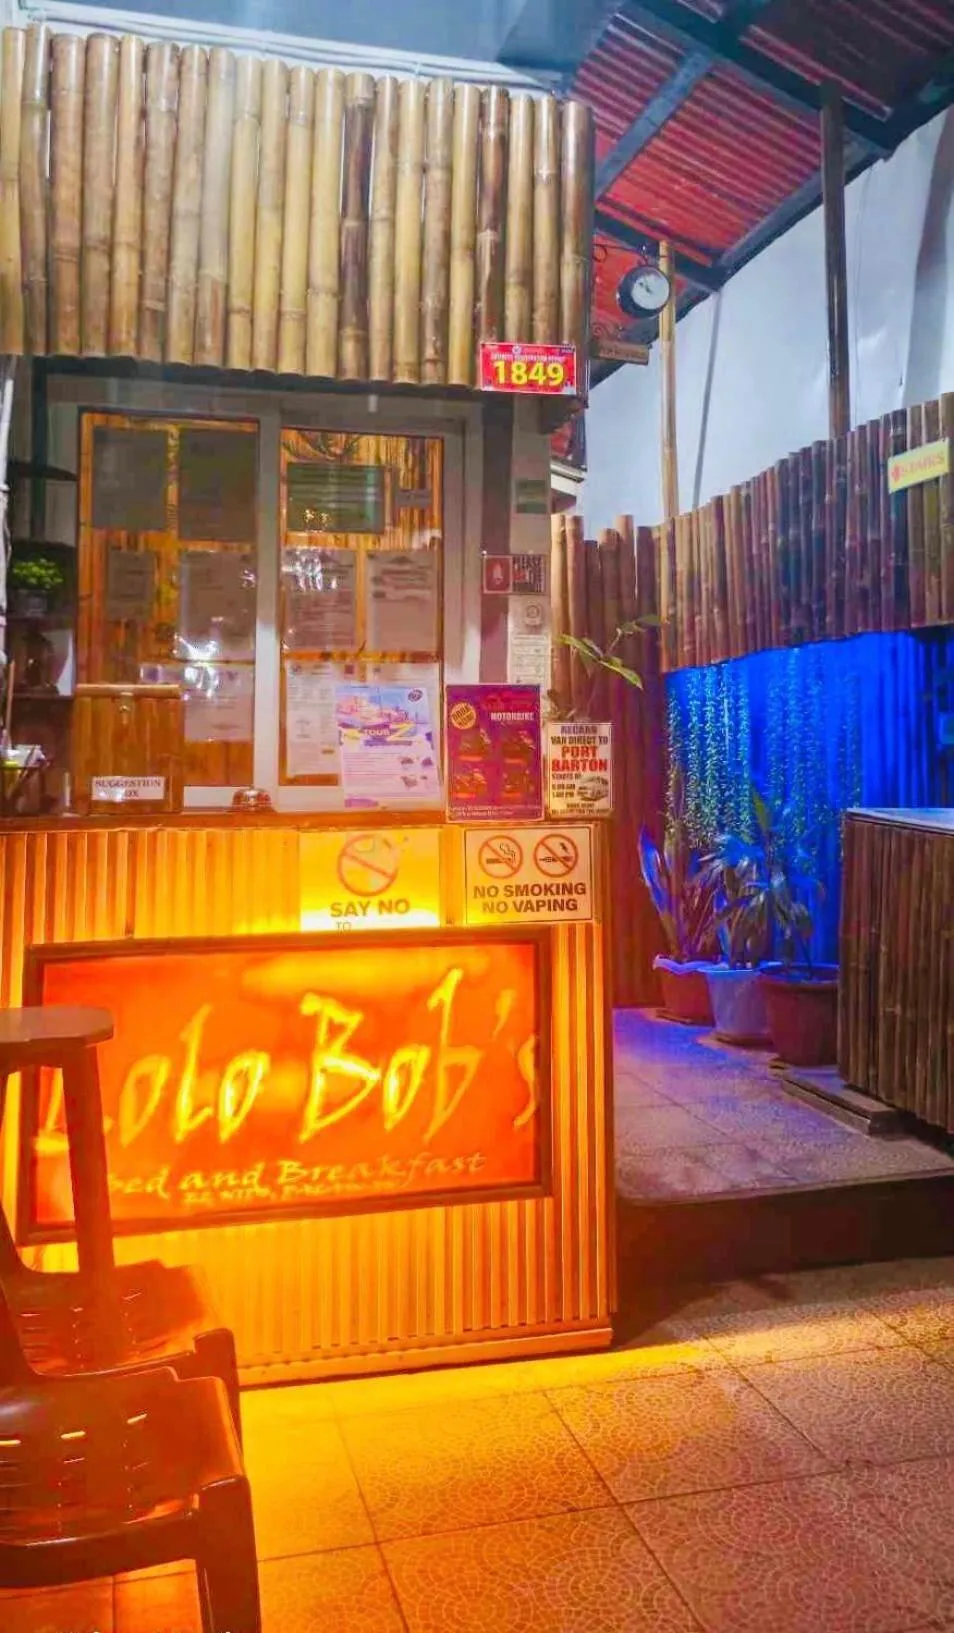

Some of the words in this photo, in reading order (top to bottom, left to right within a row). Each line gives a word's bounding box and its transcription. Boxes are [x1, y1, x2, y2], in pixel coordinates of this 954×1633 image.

[494, 360, 564, 386] 1849
[490, 712, 535, 721] MOTORBIKE
[551, 736, 567, 745] VAN
[568, 736, 596, 745] DIRECT
[598, 735, 609, 745] TO
[561, 745, 598, 758] PORT
[551, 758, 608, 772] BARTON
[95, 779, 161, 789] SUGGESTION
[473, 885, 499, 899] NO
[503, 882, 587, 898] SMOKING
[330, 900, 371, 918] SAY
[378, 898, 410, 915] NO
[482, 900, 509, 914] NO
[513, 898, 578, 913] VAPING
[298, 967, 537, 1143] Bob's
[180, 1162, 264, 1191] and
[277, 1150, 487, 1188] Breakfast
